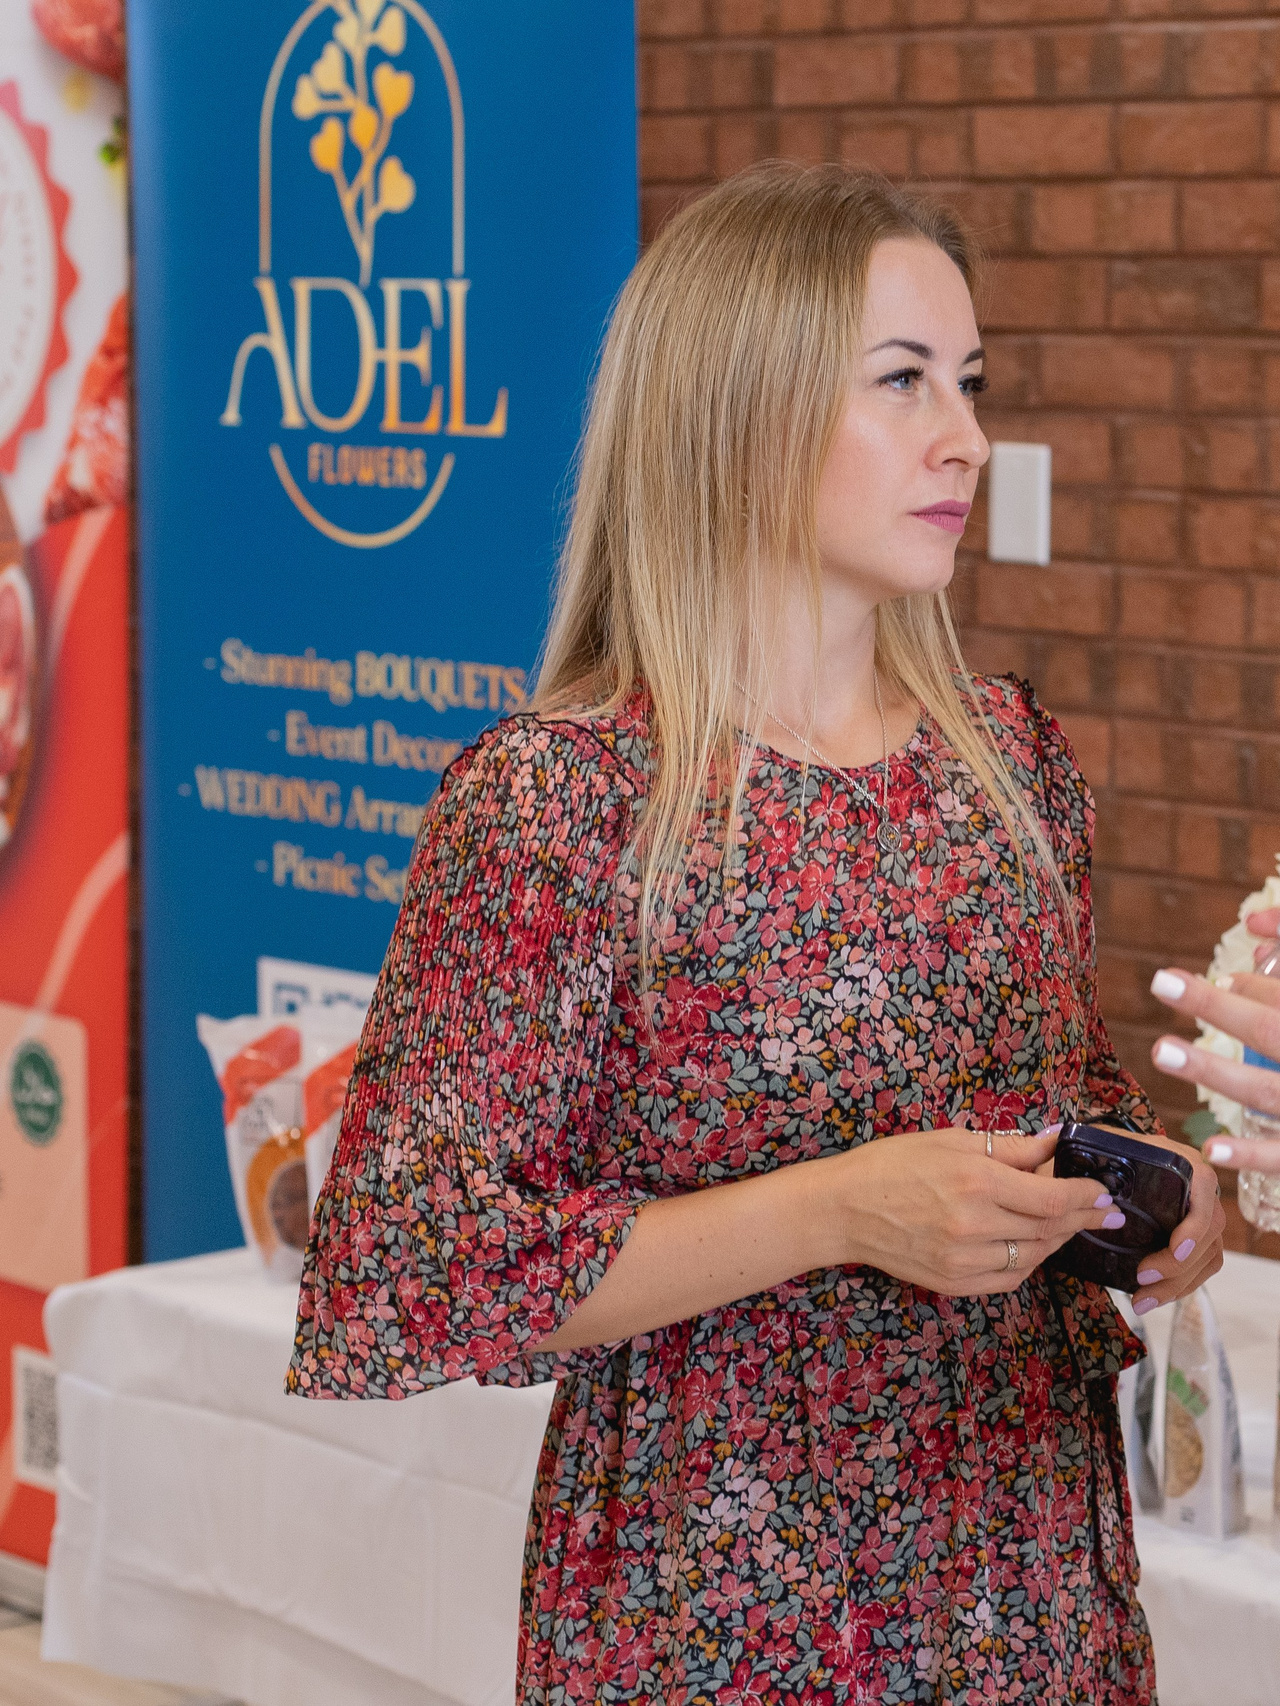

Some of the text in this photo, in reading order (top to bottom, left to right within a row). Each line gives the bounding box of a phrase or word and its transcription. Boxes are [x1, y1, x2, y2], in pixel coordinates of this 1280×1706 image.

[219, 276, 509, 438] ADEL
[307, 441, 428, 490] FLOWERS
[220, 637, 527, 714] Stunning BOUQUETS
[285, 709, 368, 765] Event
[194, 764, 342, 828] WEDDING
[272, 840, 362, 898] Picnic
